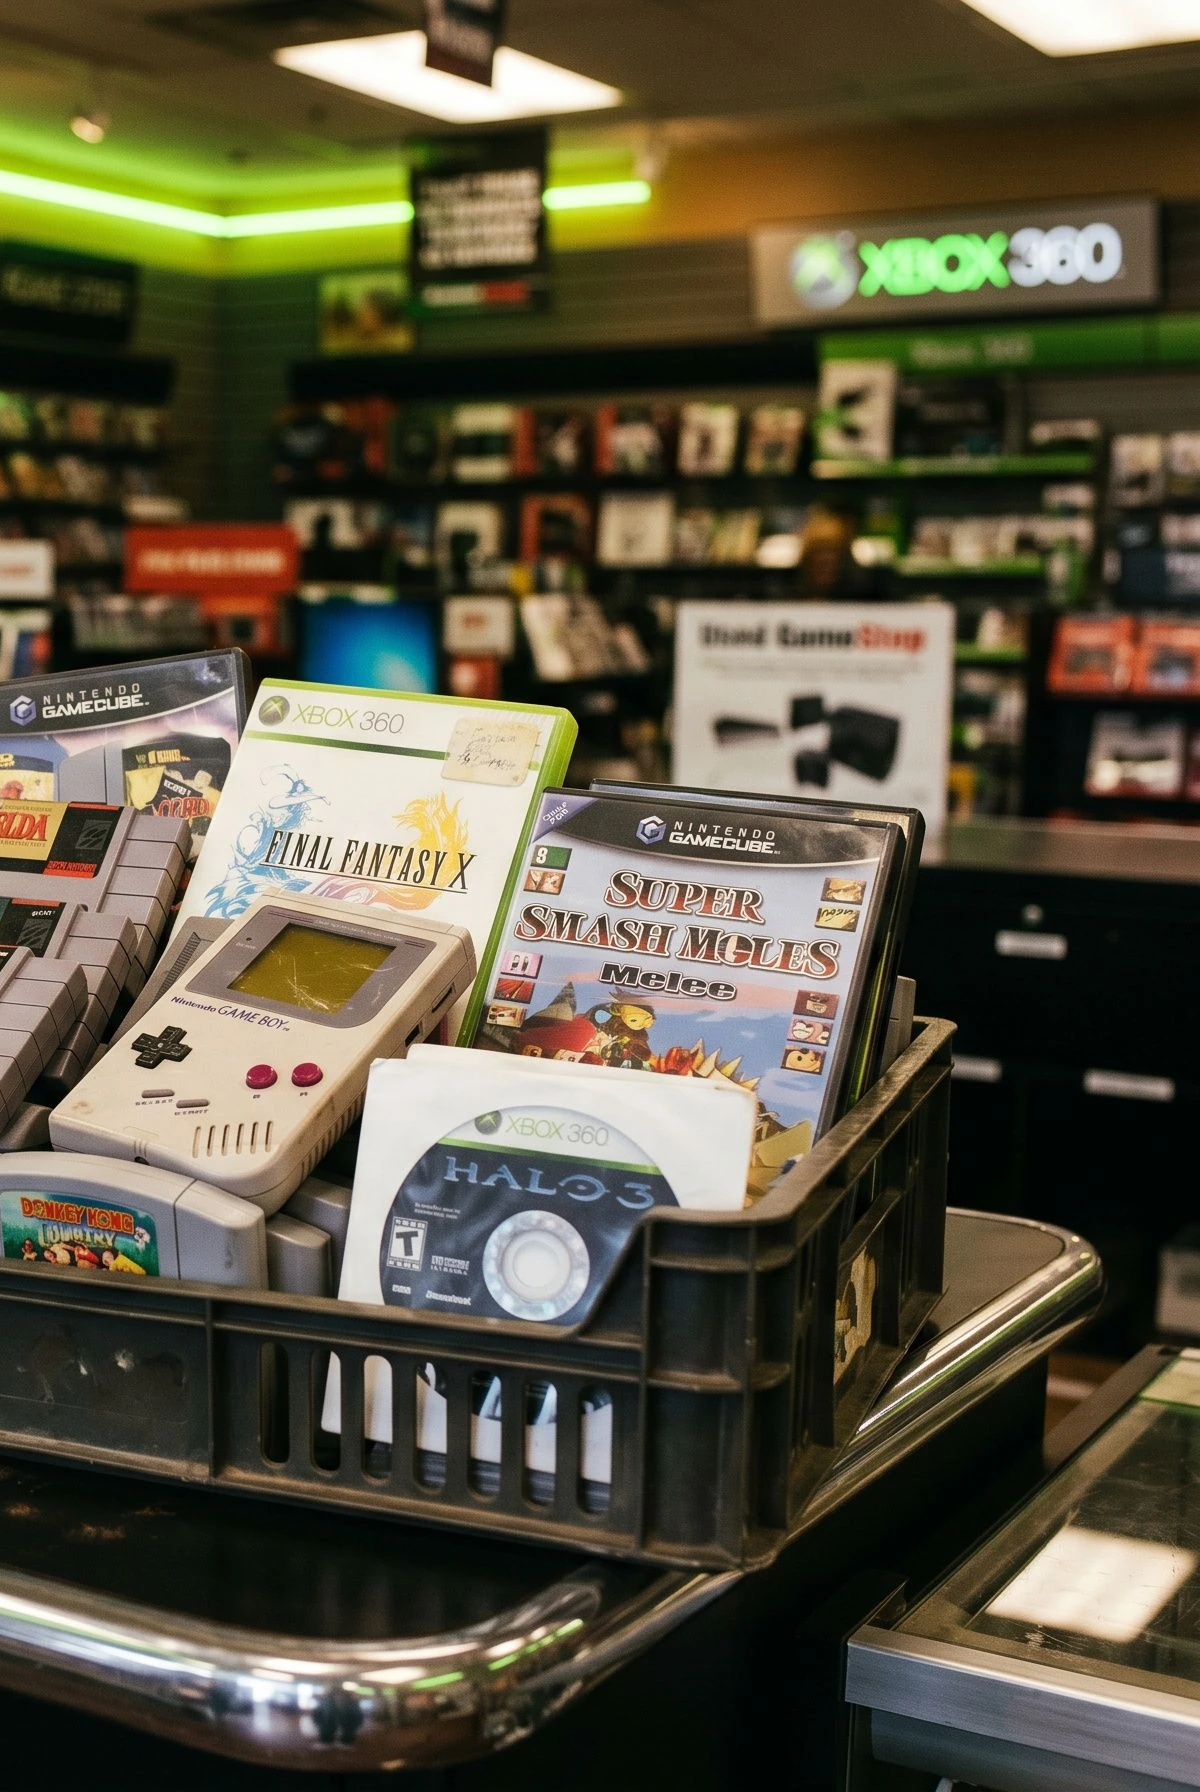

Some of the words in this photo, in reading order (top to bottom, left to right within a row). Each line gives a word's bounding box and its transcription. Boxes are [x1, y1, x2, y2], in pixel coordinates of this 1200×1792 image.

[859, 231, 1010, 296] XBOX
[1008, 223, 1123, 289] 360
[42, 693, 146, 719] GAMECUBE
[43, 683, 141, 705] NINTENDO
[293, 703, 359, 729] XBOX
[359, 711, 405, 734] 360
[668, 832, 776, 854] GAMECUBE
[673, 820, 776, 842] NINTENDO
[263, 830, 335, 872] FINAL
[340, 840, 447, 885] FANTASY
[447, 854, 478, 890] X
[604, 869, 765, 924] SUPER
[514, 903, 677, 958] SMASH
[599, 962, 737, 1000] Melee
[171, 995, 217, 1013] Nintendo
[217, 1005, 262, 1025] GAME
[258, 1012, 291, 1031] BOY
[505, 1115, 567, 1141] XBOX
[567, 1123, 609, 1147] 360
[443, 1156, 610, 1203] HALO
[616, 1182, 655, 1209] 3
[395, 1230, 419, 1256] T
